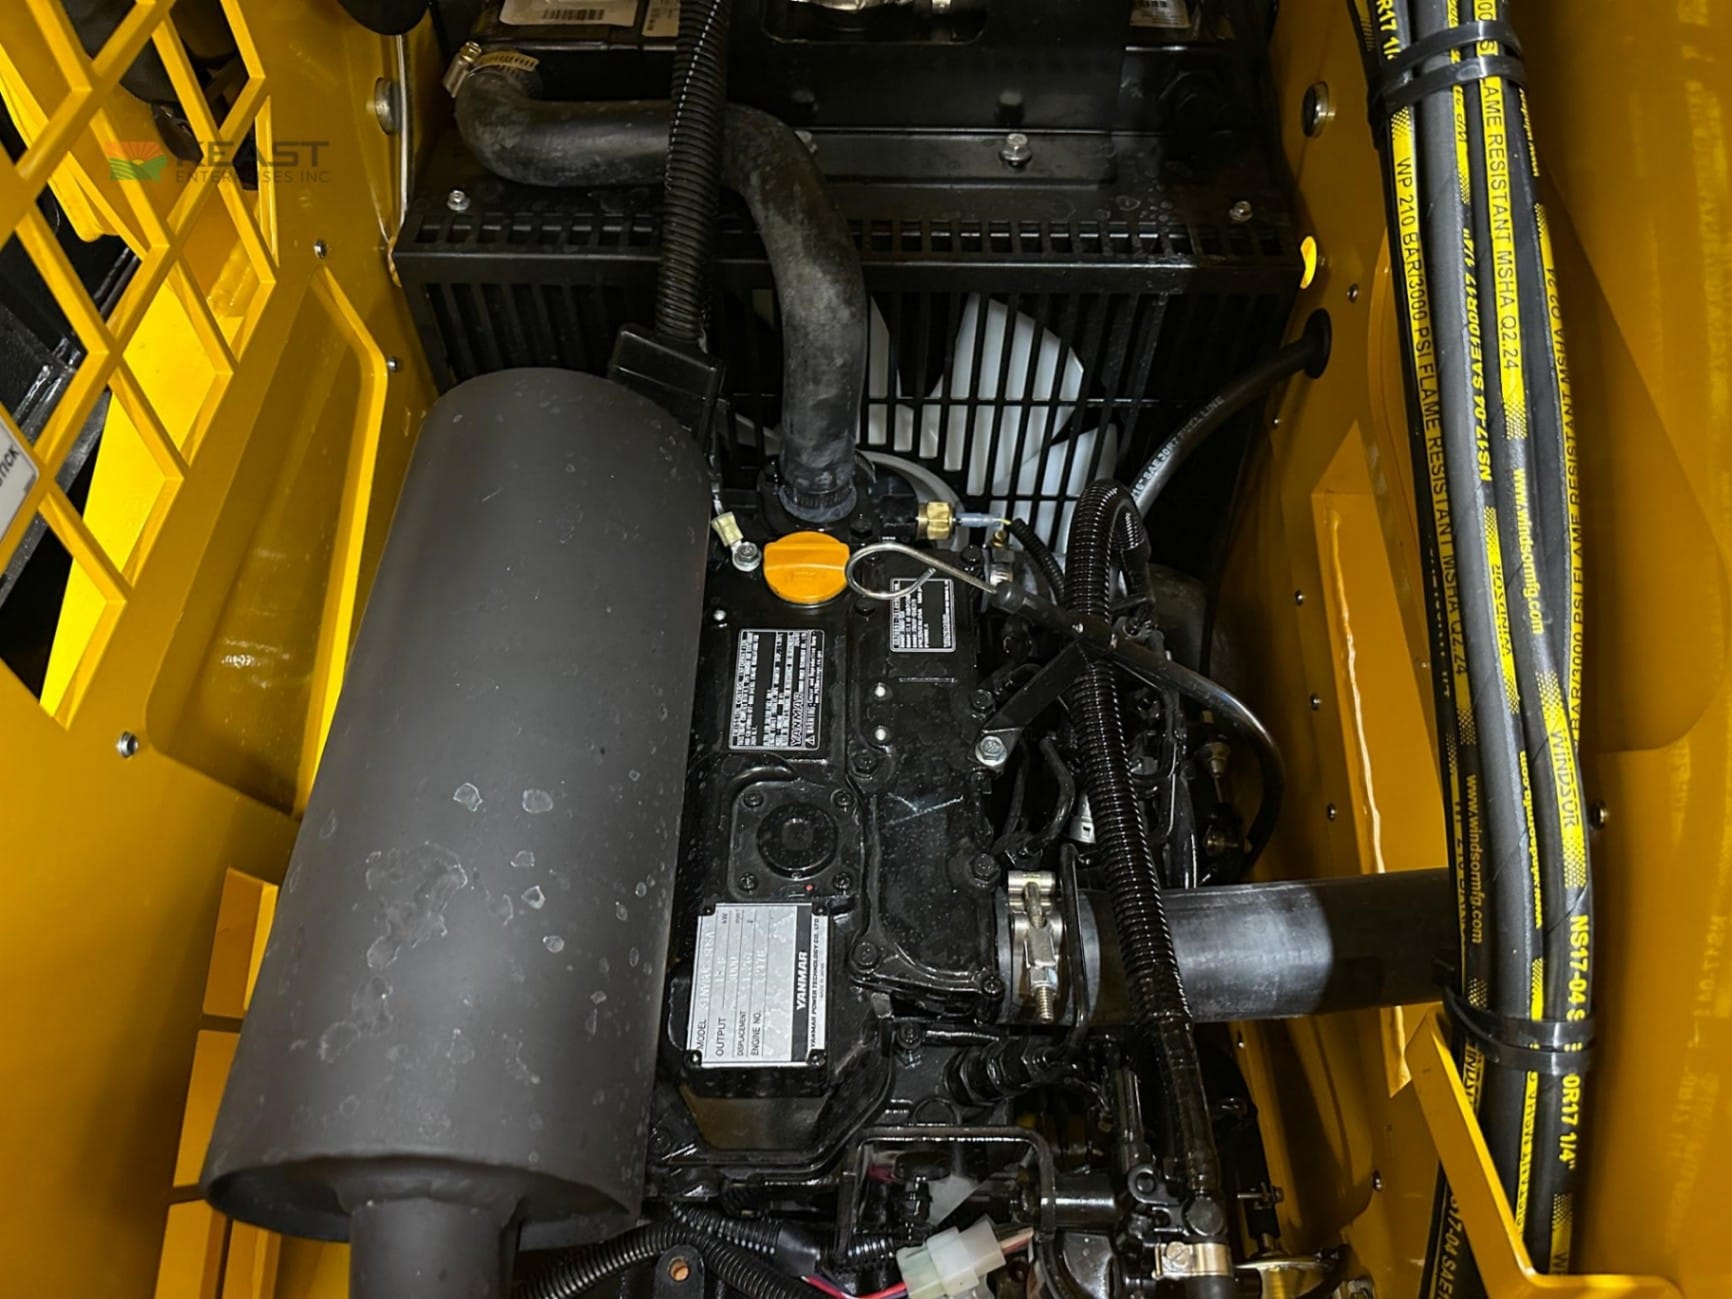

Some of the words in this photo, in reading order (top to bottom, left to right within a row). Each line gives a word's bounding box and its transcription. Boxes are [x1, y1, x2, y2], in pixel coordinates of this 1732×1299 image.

[1397, 158, 1412, 188] WP
[1489, 134, 1512, 243] RESISTANT
[1400, 195, 1415, 227] 210
[1403, 232, 1427, 320] BAR/3000
[1496, 250, 1515, 307] MSHA
[1416, 328, 1432, 359] PSI
[1501, 316, 1519, 369] Q2.24
[1419, 364, 1441, 432] FLAME
[1428, 438, 1451, 546] RESISTANT
[1513, 469, 1545, 634] www.windsormfg.com
[791, 692, 803, 745] YANMAR
[1466, 774, 1485, 944] www.windsormfg.com
[796, 952, 808, 1010] YANMAR
[1568, 915, 1589, 1004] NS17-04
[696, 1019, 707, 1049] MODEL
[716, 1017, 726, 1056] OUTPUT
[738, 1011, 746, 1056] DISPLACEMENT
[752, 1027, 761, 1056] ENGINE
